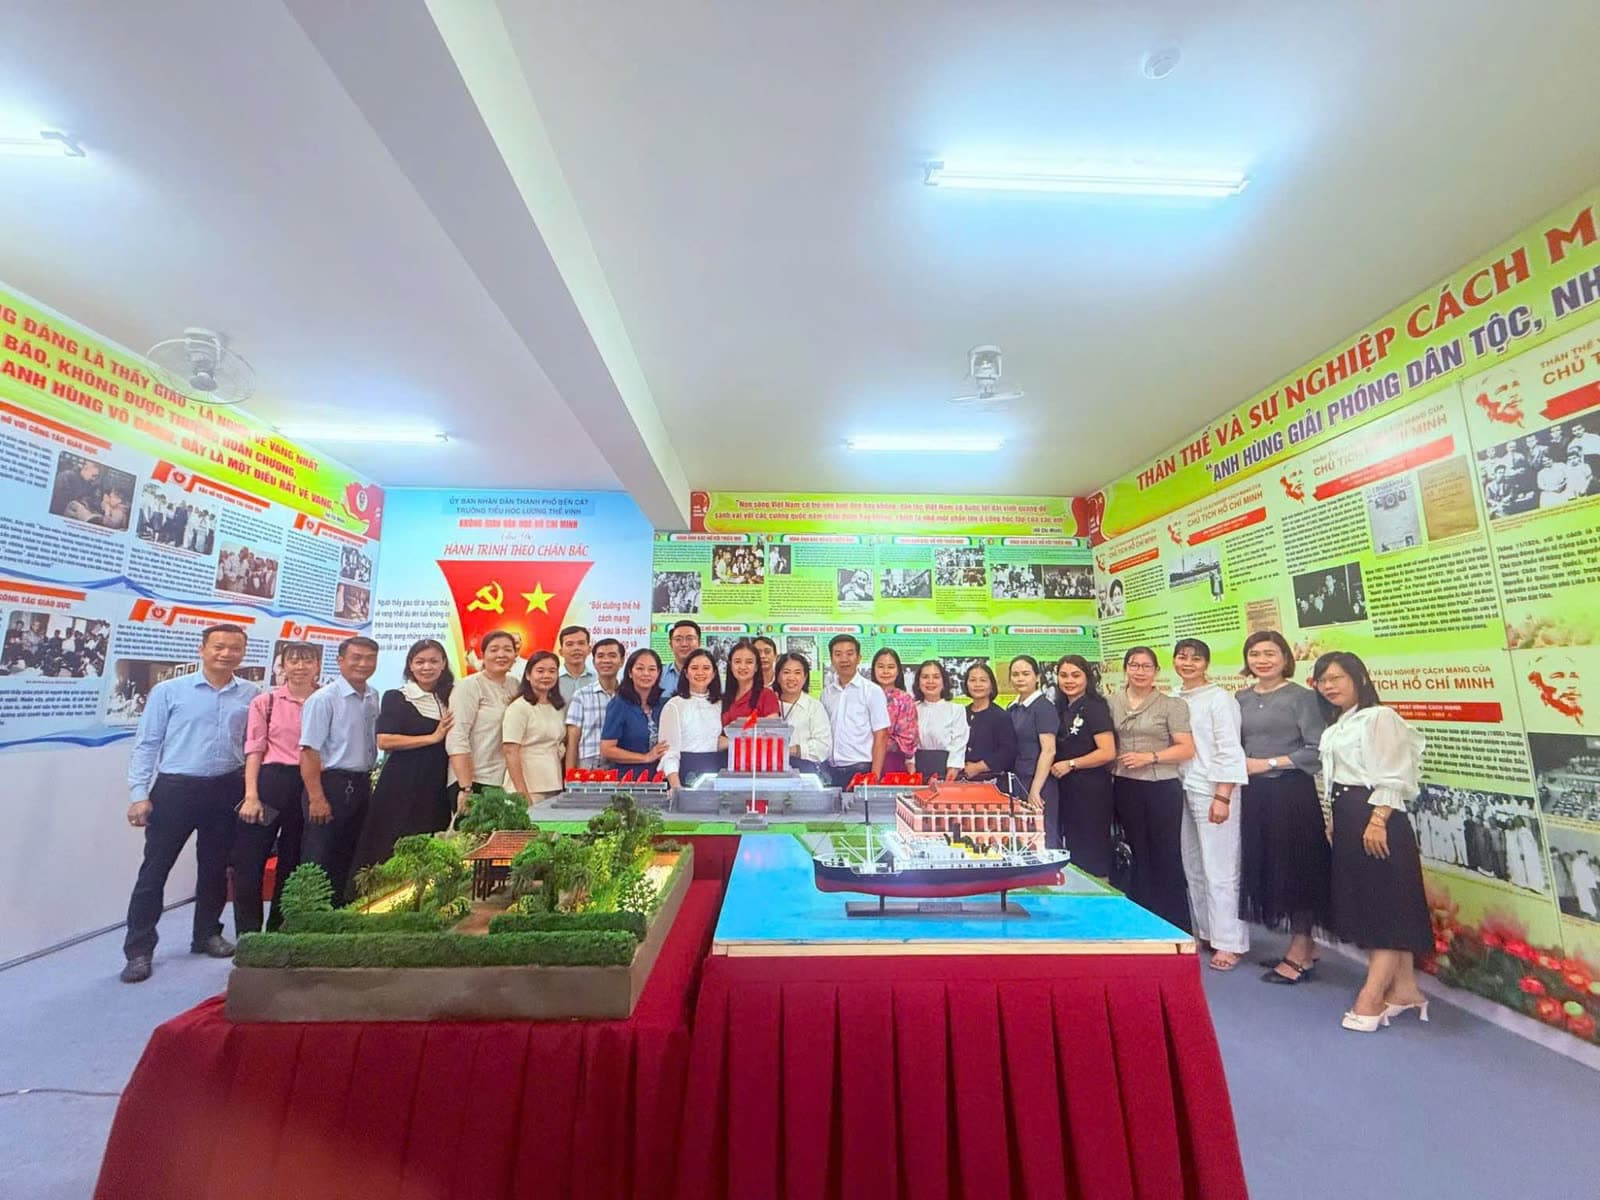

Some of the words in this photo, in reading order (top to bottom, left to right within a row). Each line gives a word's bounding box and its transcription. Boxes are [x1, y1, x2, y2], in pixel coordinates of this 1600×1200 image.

[3, 333, 51, 369] BÁO,
[58, 358, 120, 398] KHÔNG
[124, 390, 164, 418] ĐƯỢC
[23, 316, 78, 355] ĐÁNG
[84, 346, 105, 369] LÀ
[269, 438, 294, 461] VANG
[1137, 456, 1176, 491] THÂN
[1179, 426, 1212, 467] THẾ
[1215, 414, 1244, 446] VÀ
[1248, 392, 1279, 429] SỰ
[1284, 327, 1395, 408] NGHIỆP
[1407, 247, 1530, 338] CÁCH
[1243, 431, 1284, 468] HÙNG
[1288, 409, 1322, 445] GIẢI
[1327, 371, 1400, 426] PHÓNG
[1406, 339, 1464, 388] DÂN
[1468, 306, 1543, 356] TỘC,
[1543, 355, 1586, 385] CHỦ
[2, 359, 48, 389] ANH
[51, 379, 104, 413] HÙNG
[210, 450, 224, 466] LÀ
[228, 457, 250, 475] MỘT
[253, 469, 277, 487] ĐIỀU
[565, 507, 582, 515] VINH
[477, 543, 508, 556] TRÌNH
[511, 544, 535, 556] THEO
[569, 542, 589, 557] BÁC
[1403, 675, 1422, 690] HỒ
[1425, 676, 1450, 689] CHÍ
[1454, 677, 1495, 689] MINH
[1422, 665, 1444, 675] CÁCH
